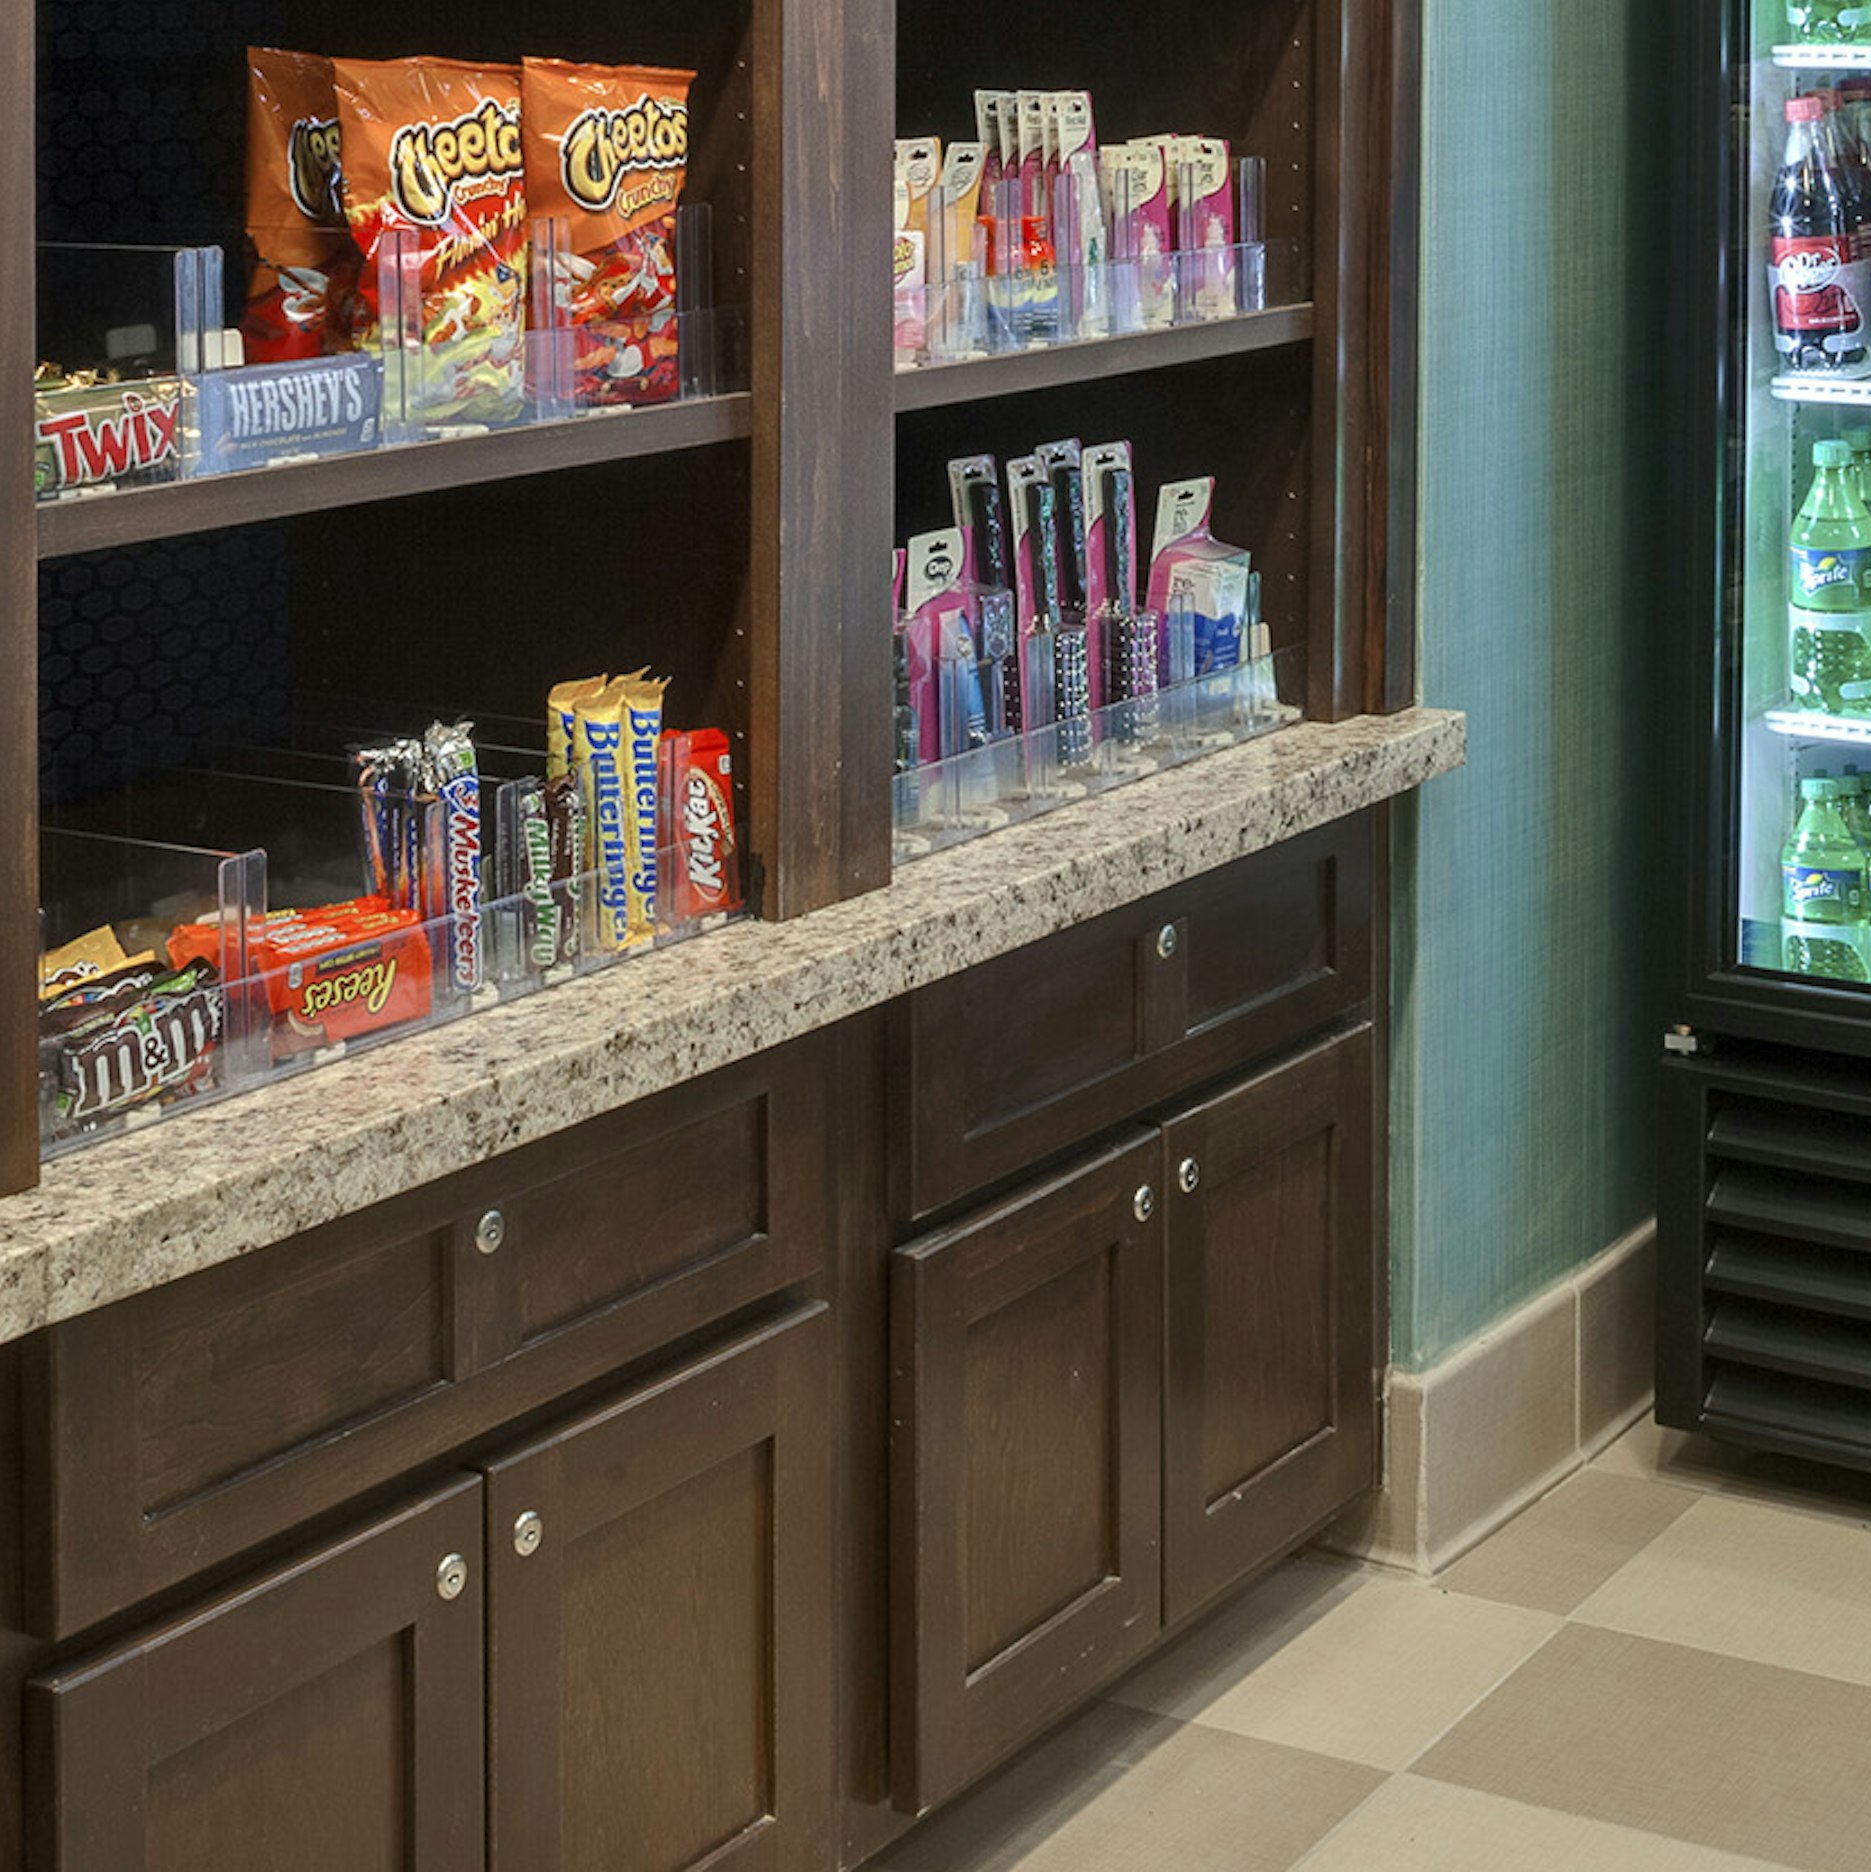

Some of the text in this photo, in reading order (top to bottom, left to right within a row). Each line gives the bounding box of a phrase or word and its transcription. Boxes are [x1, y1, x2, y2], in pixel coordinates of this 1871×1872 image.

[568, 96, 687, 202] Cheetos
[616, 173, 677, 219] Crunchy
[229, 366, 363, 439] HERSHEY'S
[1800, 564, 1849, 592] Sprite
[583, 719, 628, 943] Butterfinger
[451, 813, 481, 986] Musketeers
[300, 958, 399, 1020] Reese's
